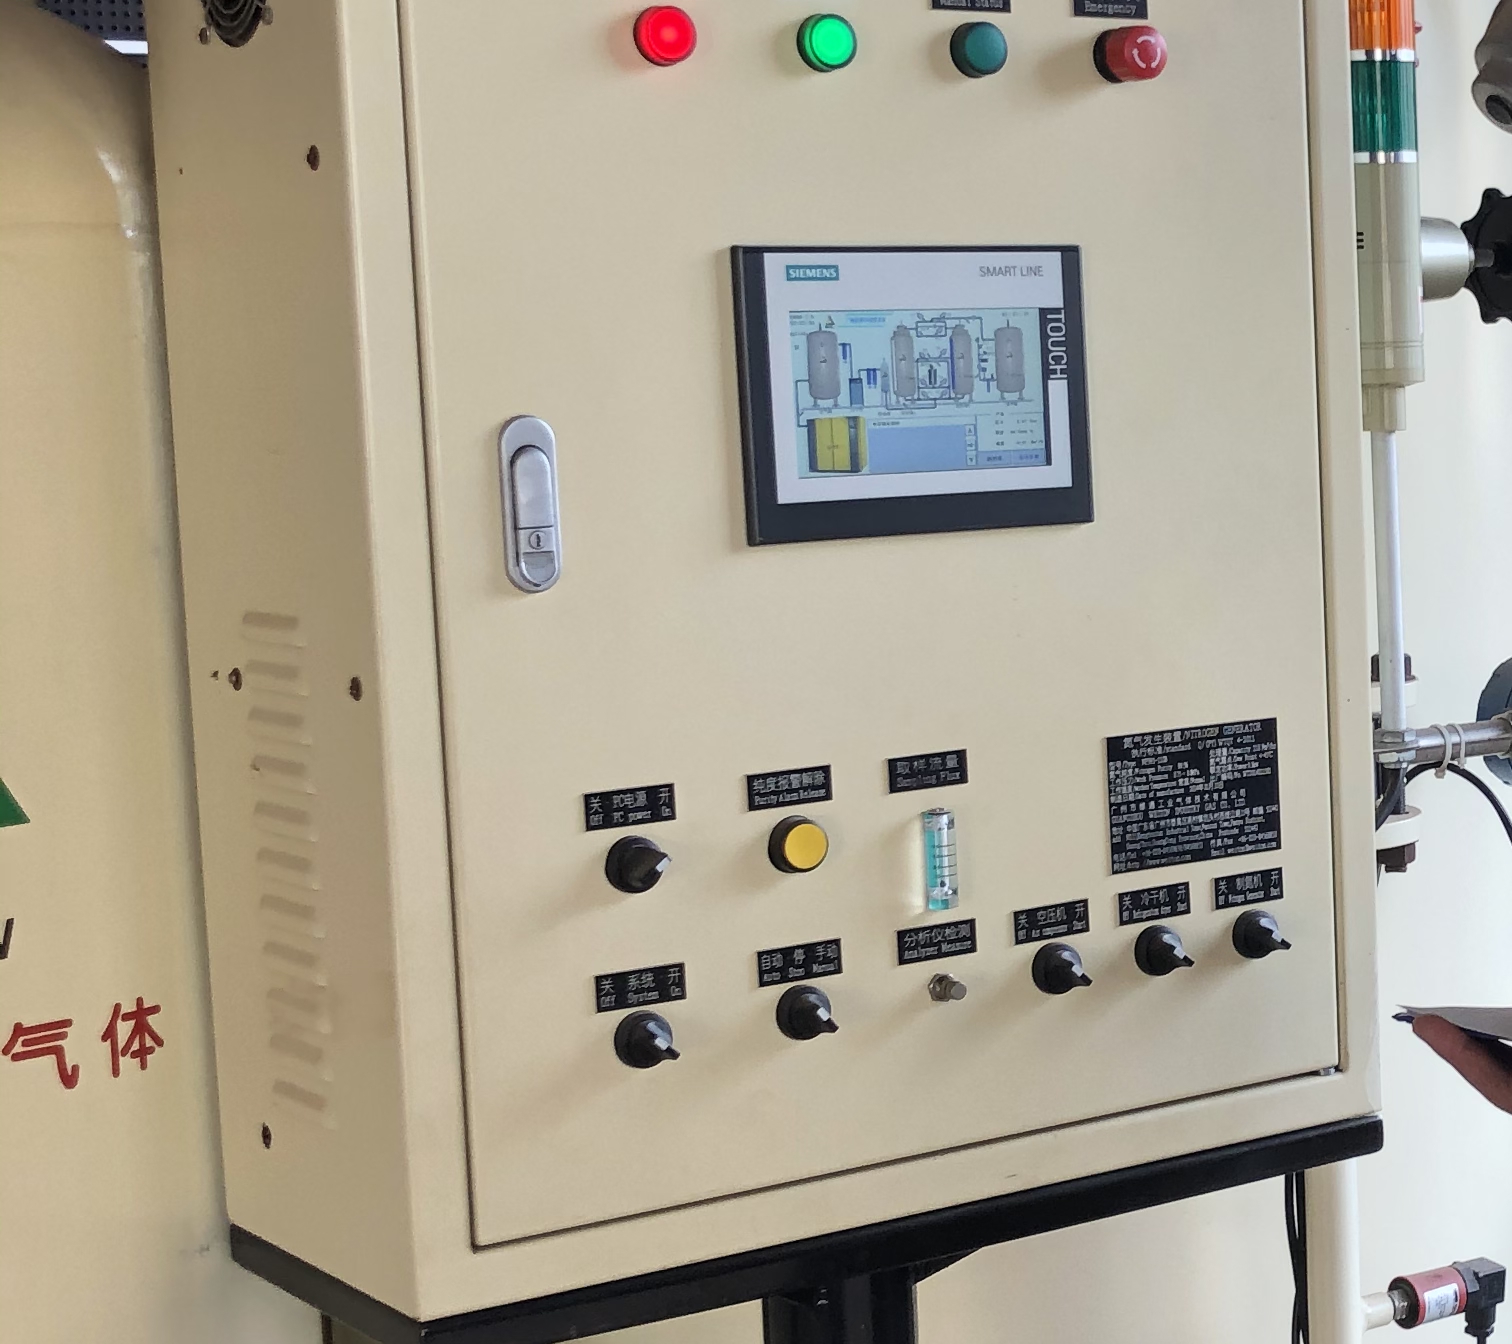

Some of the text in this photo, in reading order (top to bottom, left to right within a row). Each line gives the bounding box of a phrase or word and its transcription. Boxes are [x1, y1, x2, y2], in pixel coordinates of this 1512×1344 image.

[788, 267, 837, 278] SIEMENS
[978, 265, 1044, 278] SMART LINE
[1045, 310, 1068, 380] TOUCH
[895, 754, 960, 775] 取样流量
[752, 770, 826, 794] 纯度报警解除
[589, 796, 603, 813] 关
[658, 787, 671, 805] 开
[1218, 879, 1228, 895] 关
[1270, 870, 1280, 886] 开
[1122, 885, 1186, 910] 关 冷干机 开
[1017, 903, 1086, 929] 关 空压机 开
[903, 923, 971, 948] 分析仪检测
[760, 943, 839, 970] 自动 停 手动
[600, 967, 681, 996] 关 系统 开
